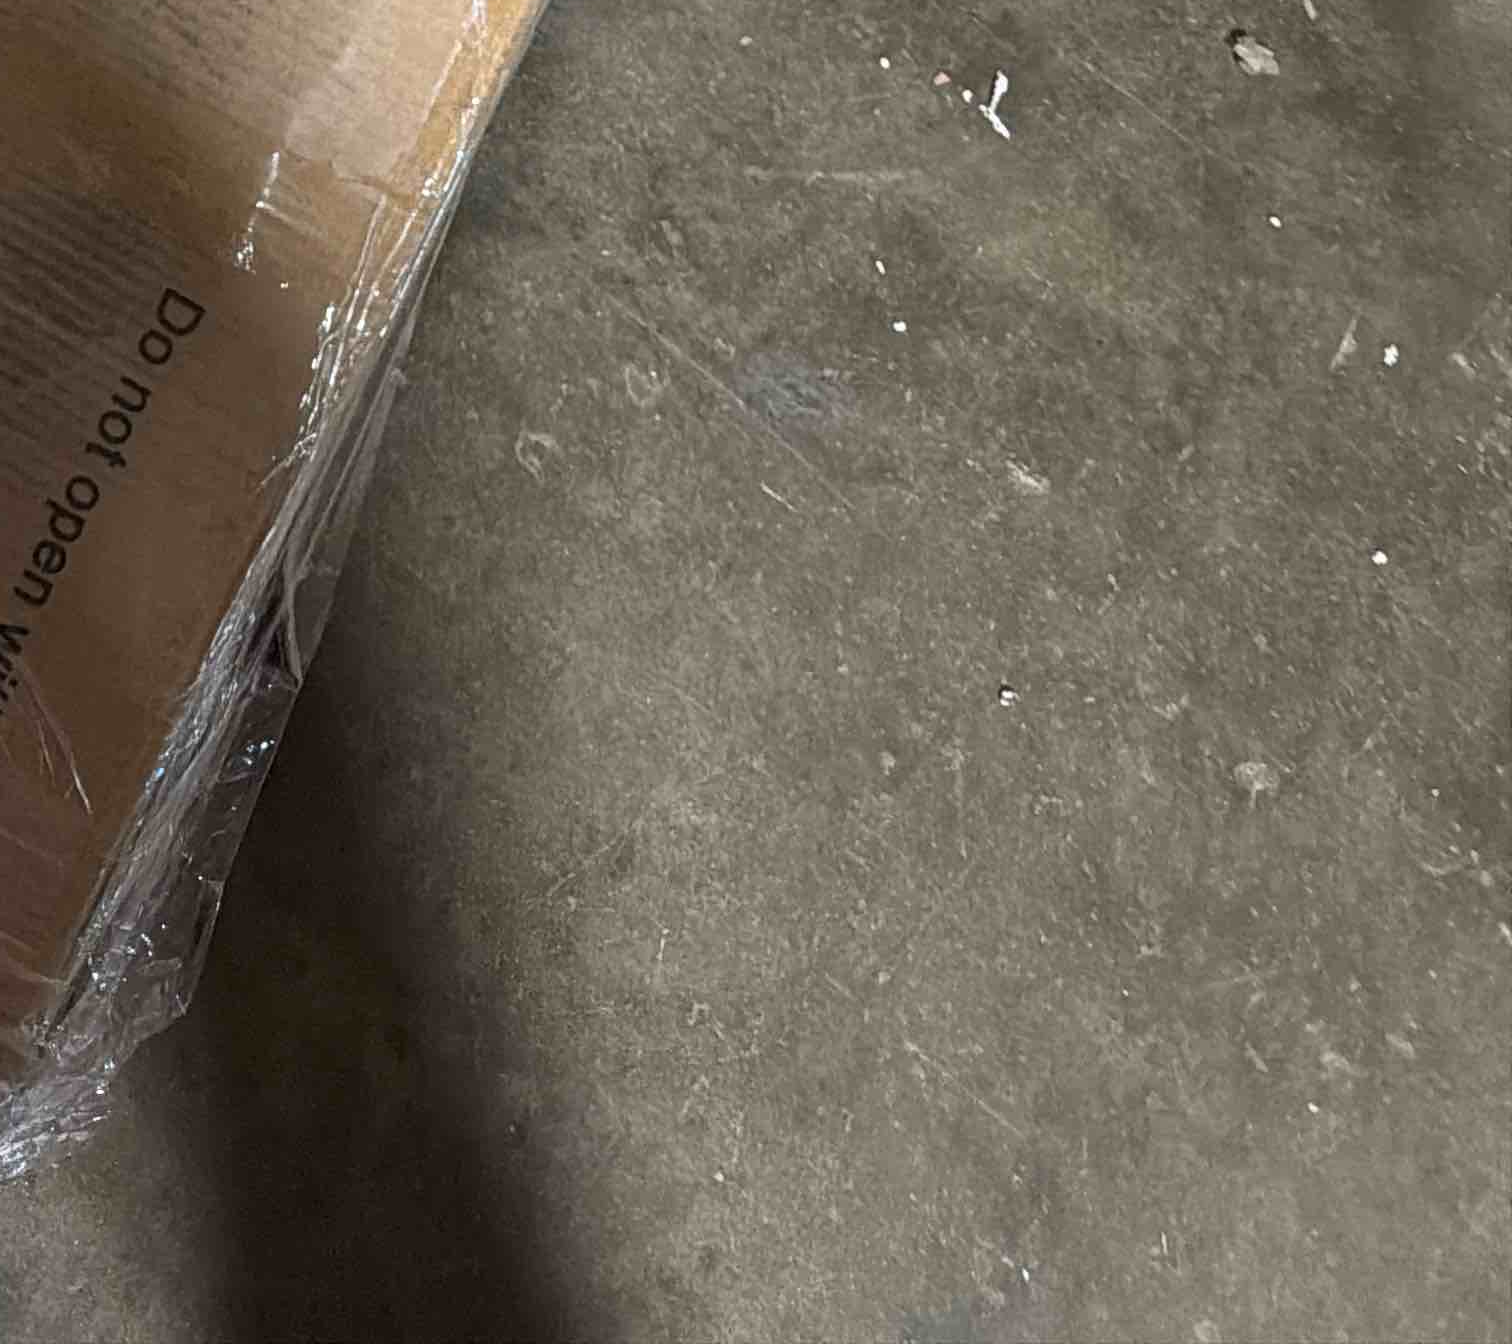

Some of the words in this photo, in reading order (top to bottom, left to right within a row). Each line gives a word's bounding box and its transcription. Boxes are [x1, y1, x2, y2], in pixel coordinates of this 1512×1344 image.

[137, 287, 205, 365] Do
[84, 376, 150, 467] not
[13, 475, 99, 607] open
